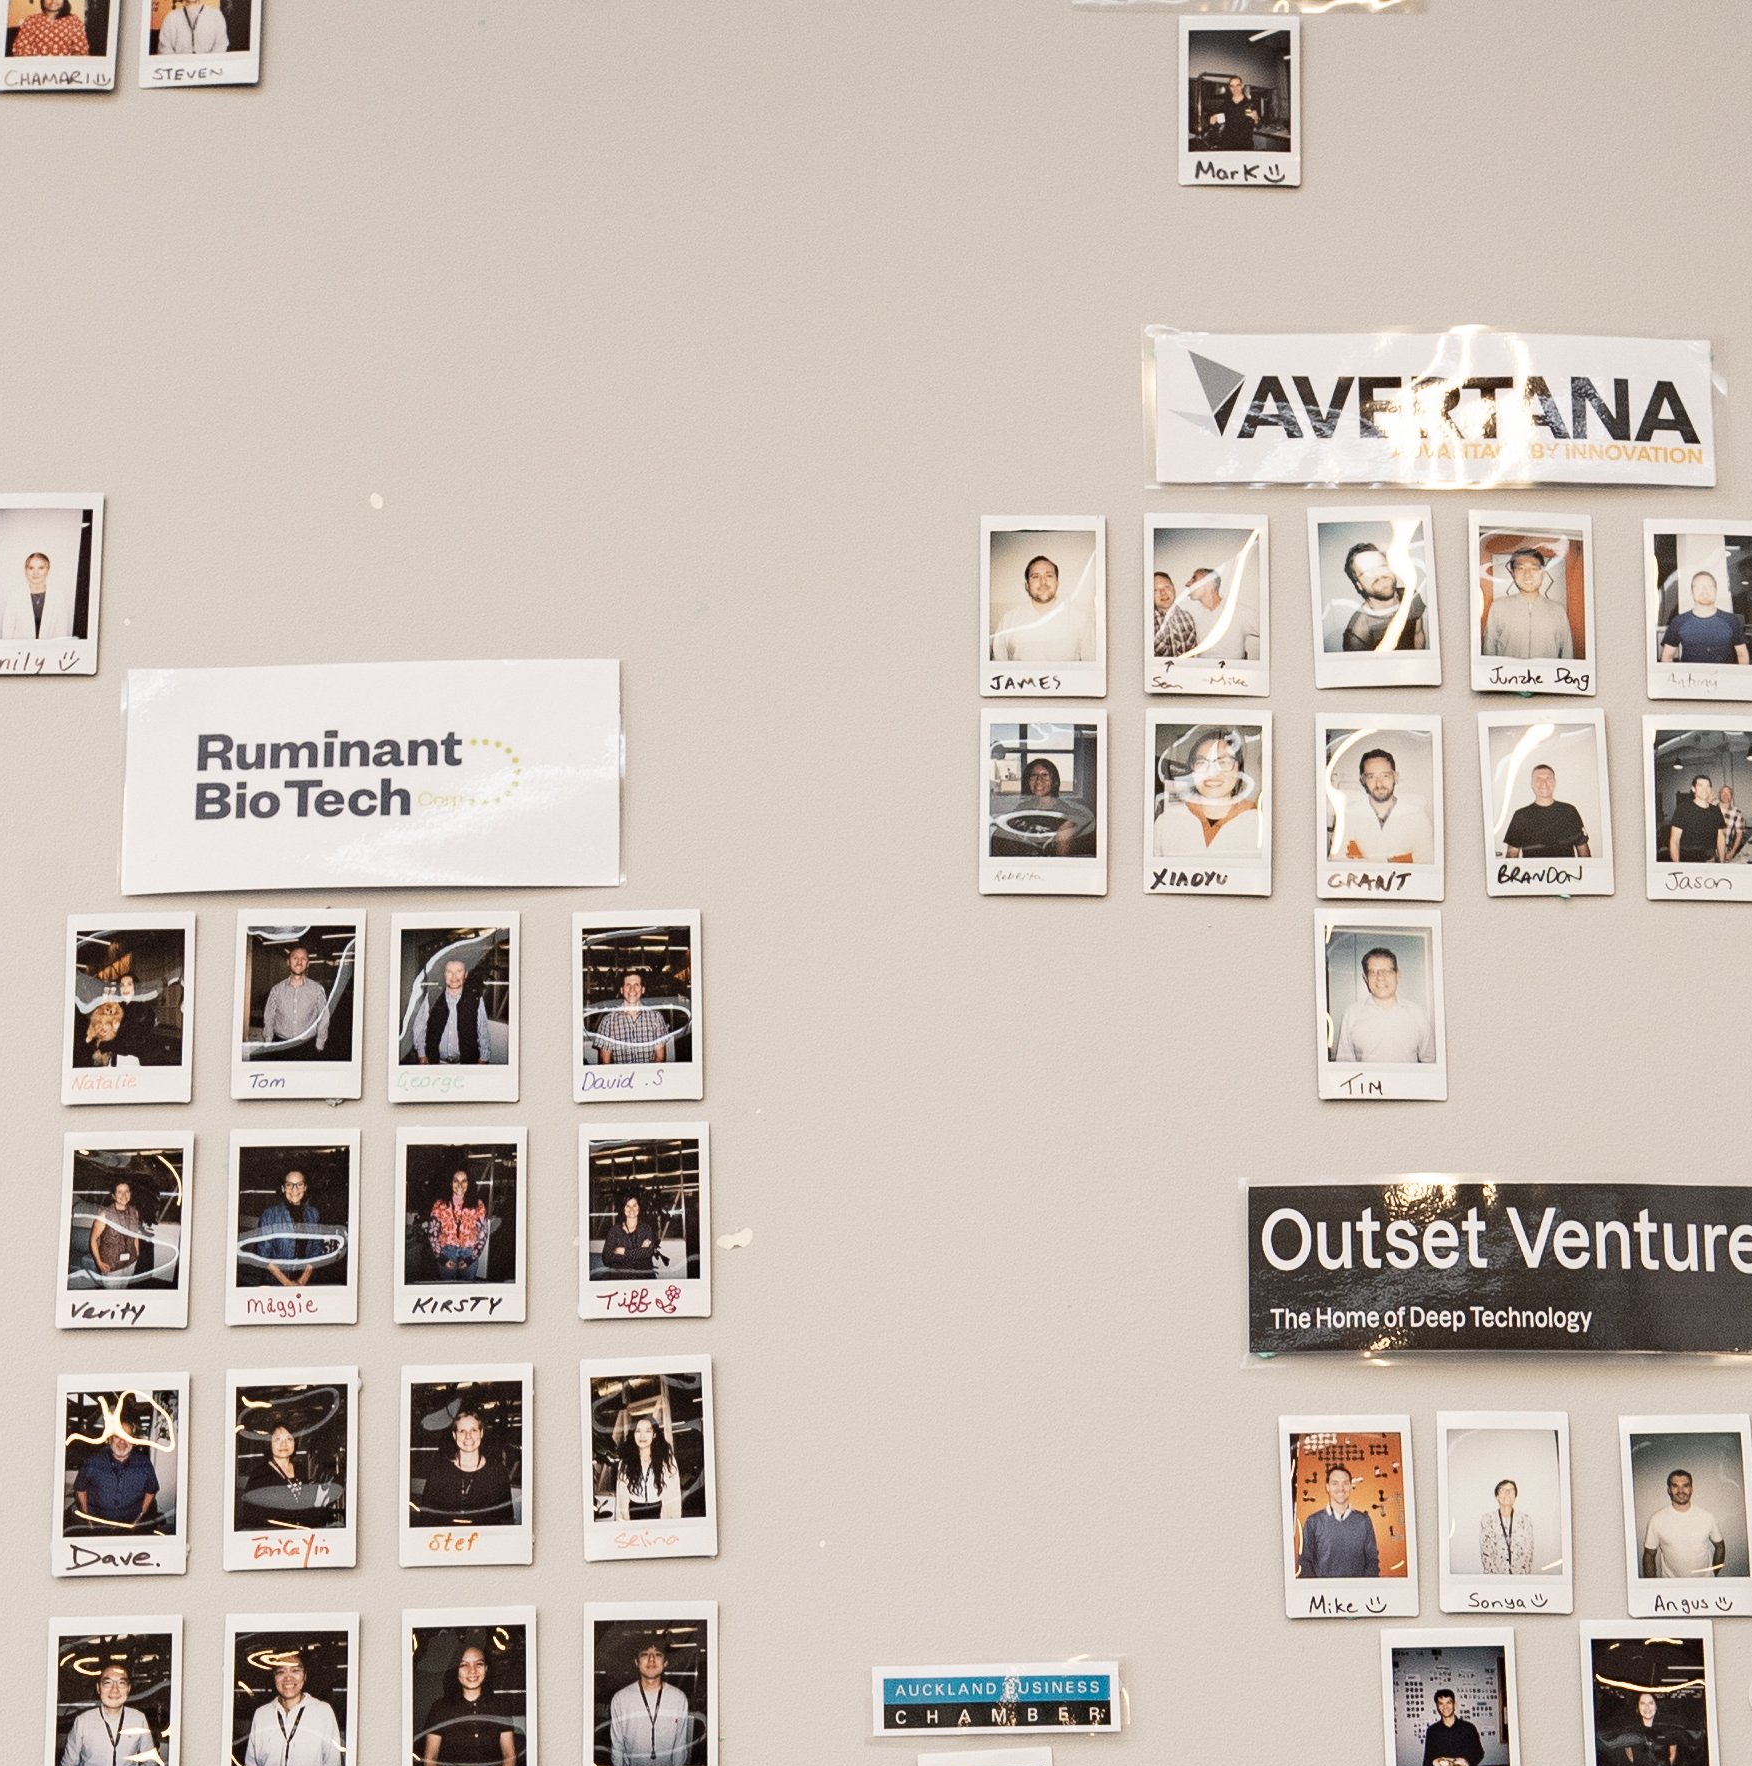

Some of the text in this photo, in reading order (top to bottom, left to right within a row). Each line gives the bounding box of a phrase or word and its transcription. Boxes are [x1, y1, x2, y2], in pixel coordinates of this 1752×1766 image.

[3, 67, 90, 91] CHAMARI
[152, 67, 224, 82] STEVEN
[1565, 445, 1704, 466] INNOVATION
[989, 673, 1062, 691] JAMES
[196, 729, 463, 772] Ruminant
[194, 778, 412, 821] Bio Tech
[1327, 870, 1413, 895] GRANT
[1497, 865, 1585, 886] BRANDON
[1664, 871, 1734, 893] Jason
[249, 1072, 286, 1090] Tom
[581, 1070, 636, 1092] David
[1338, 1072, 1384, 1097] TIM
[1260, 1206, 1488, 1273] Outset
[412, 1295, 503, 1315] KIRSTY
[1270, 1305, 1594, 1334] The Home of Deep Technology
[1308, 1594, 1359, 1616] Mike
[1468, 1591, 1528, 1611] Sonya
[1653, 1593, 1710, 1614] Angus
[894, 1681, 997, 1697] AUCKLAND
